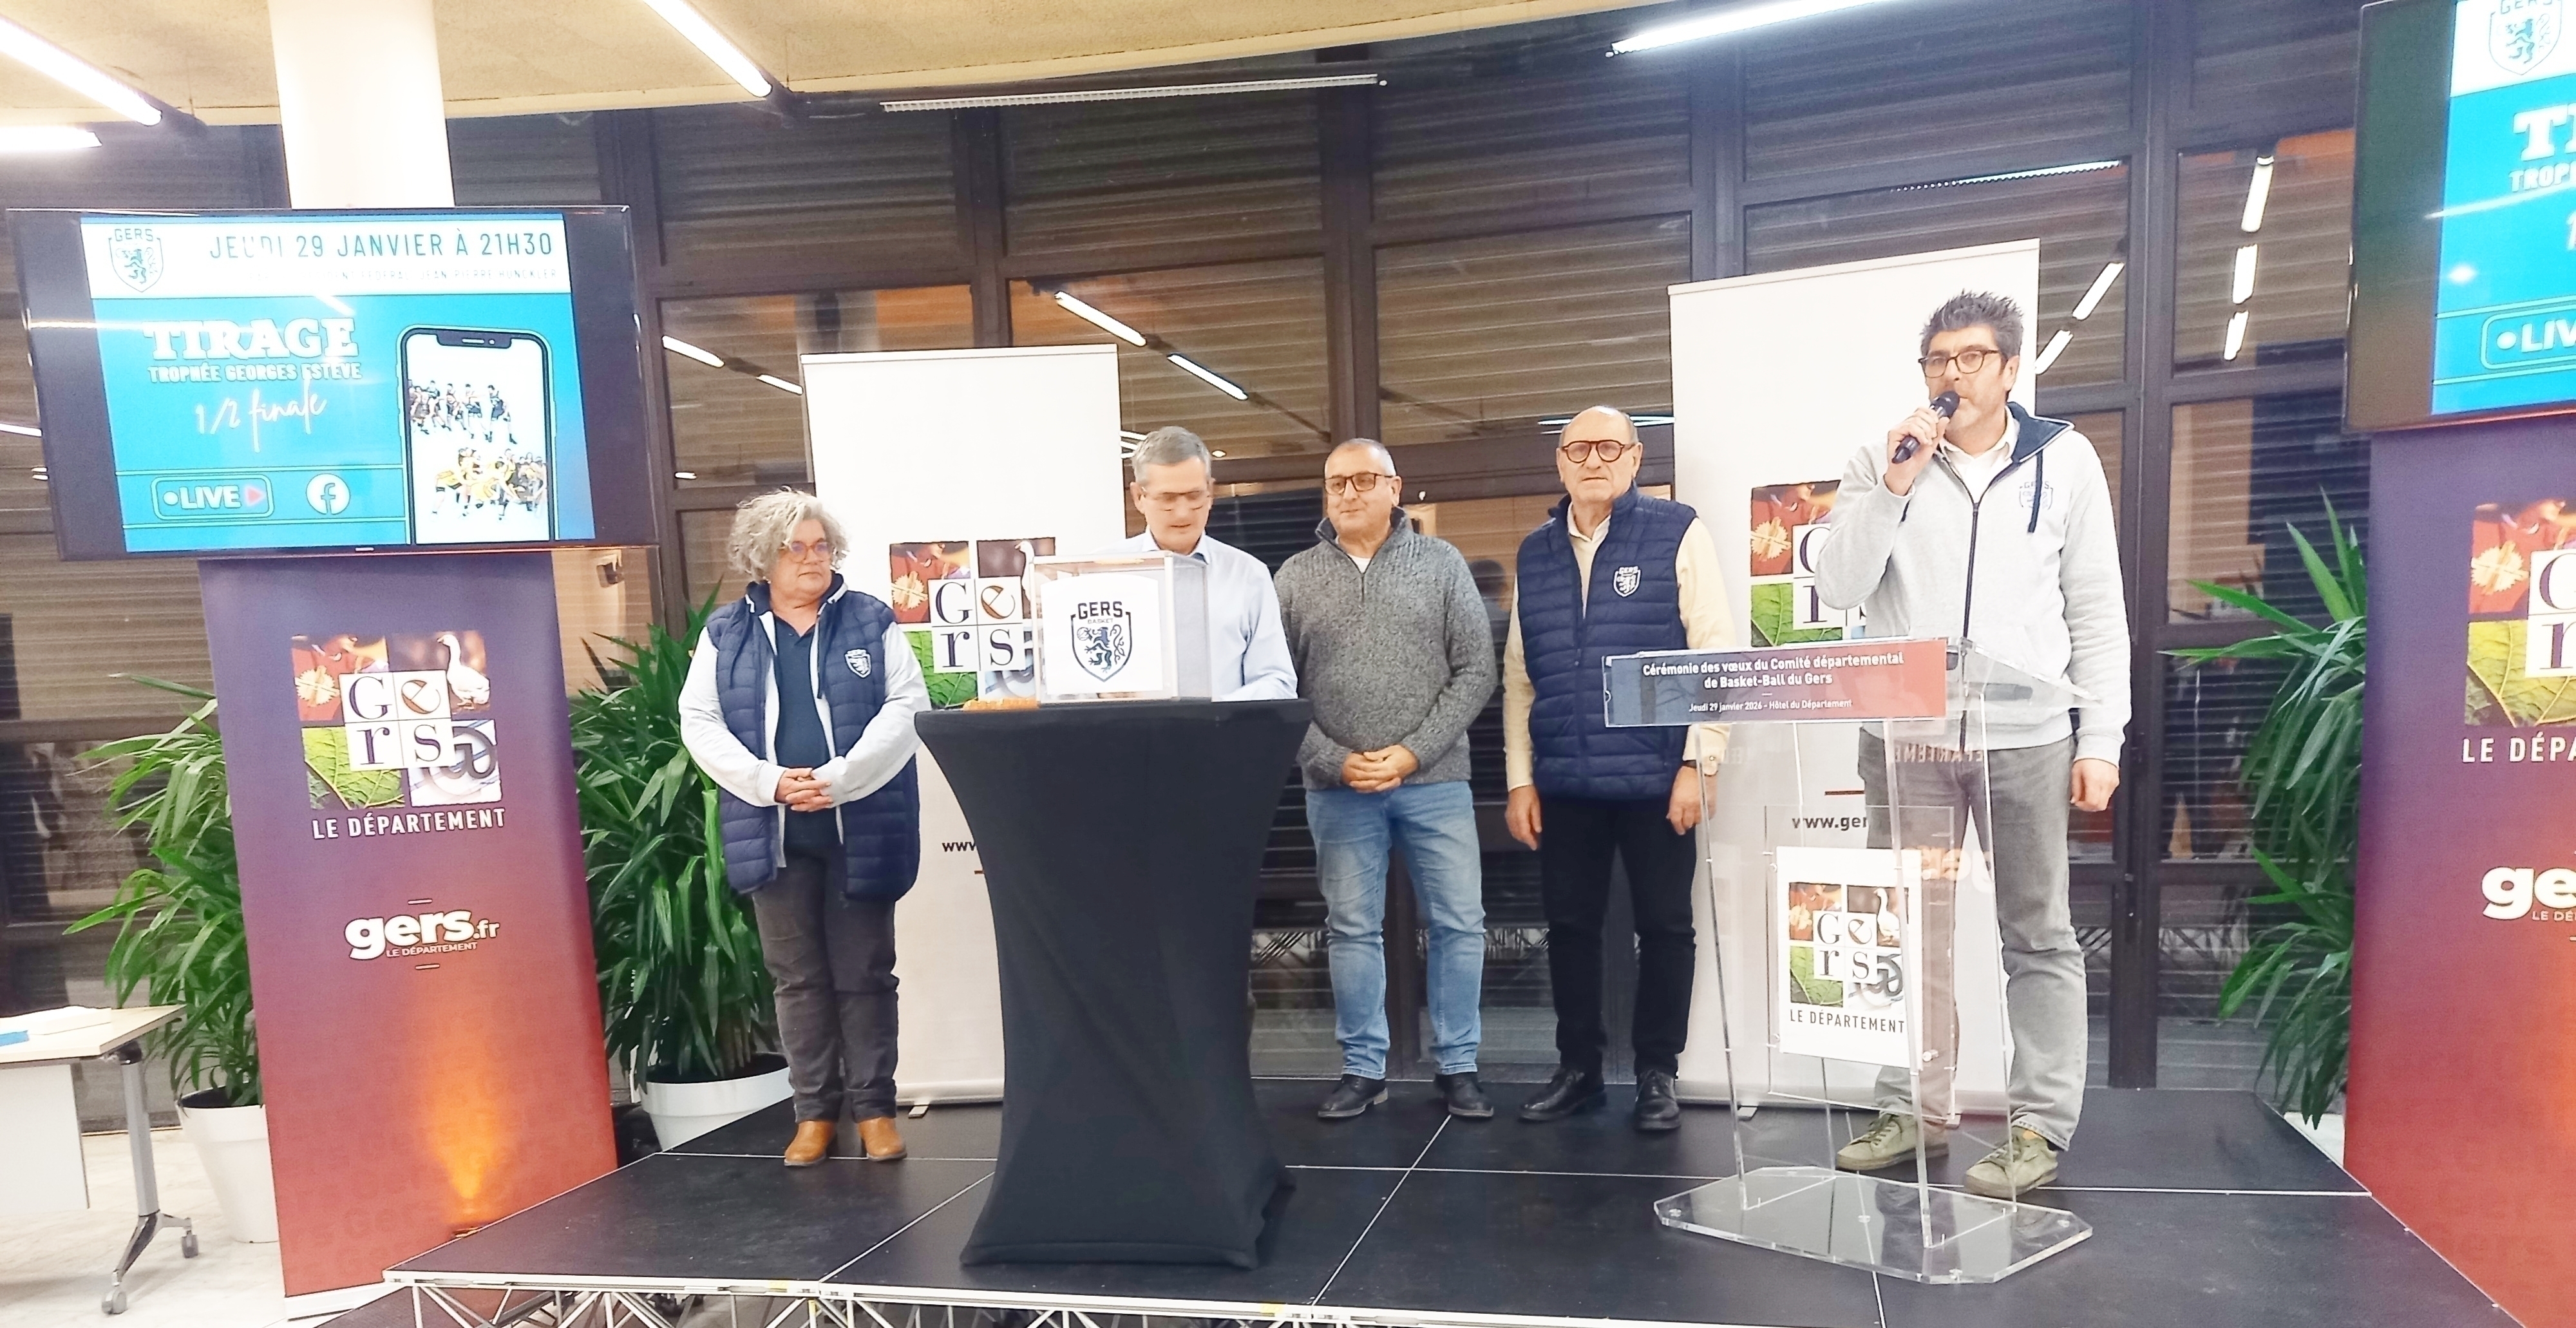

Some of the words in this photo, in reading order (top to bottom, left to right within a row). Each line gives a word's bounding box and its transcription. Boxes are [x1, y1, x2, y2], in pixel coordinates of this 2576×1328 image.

[114, 228, 153, 242] GERS
[296, 235, 323, 258] 29
[337, 234, 443, 257] JANVIER
[456, 228, 468, 256] À
[480, 232, 551, 255] 21H30
[142, 318, 359, 361] TIRAGE
[147, 361, 222, 383] TROPHÉE
[225, 363, 297, 382] GEORGES
[249, 377, 327, 453] finale
[179, 485, 242, 510] LIVE
[1077, 601, 1123, 620] GERS
[1643, 662, 1699, 676] Cérémonie
[1700, 661, 1720, 673] des
[1722, 662, 1752, 672] vœux
[1754, 658, 1768, 670] du
[1770, 655, 1811, 670] Comité
[1813, 651, 1904, 670] départemental
[1704, 677, 1718, 689] de
[1719, 674, 1786, 688] Basket-Ball
[1788, 672, 1802, 685] du
[1804, 672, 1833, 685] Gers
[1689, 703, 1709, 712] Jeudi
[1709, 703, 1718, 712] 29
[1718, 703, 1744, 713] janvier
[1745, 702, 1763, 710] 2026
[1769, 699, 1789, 709] Hôtel
[1790, 700, 1800, 708] du
[1801, 699, 1852, 710] Département
[2462, 737, 2496, 764] LE
[312, 819, 339, 840] LE
[346, 807, 506, 838] DÉPARTEMENT
[2532, 911, 2548, 921] LE
[345, 909, 500, 960] gers.fr
[386, 947, 401, 958] LE
[401, 941, 478, 956] DÉPARTEMENT
[1790, 1009, 1803, 1023] LE
[1810, 1009, 1905, 1033] DÉPARTEMENT
